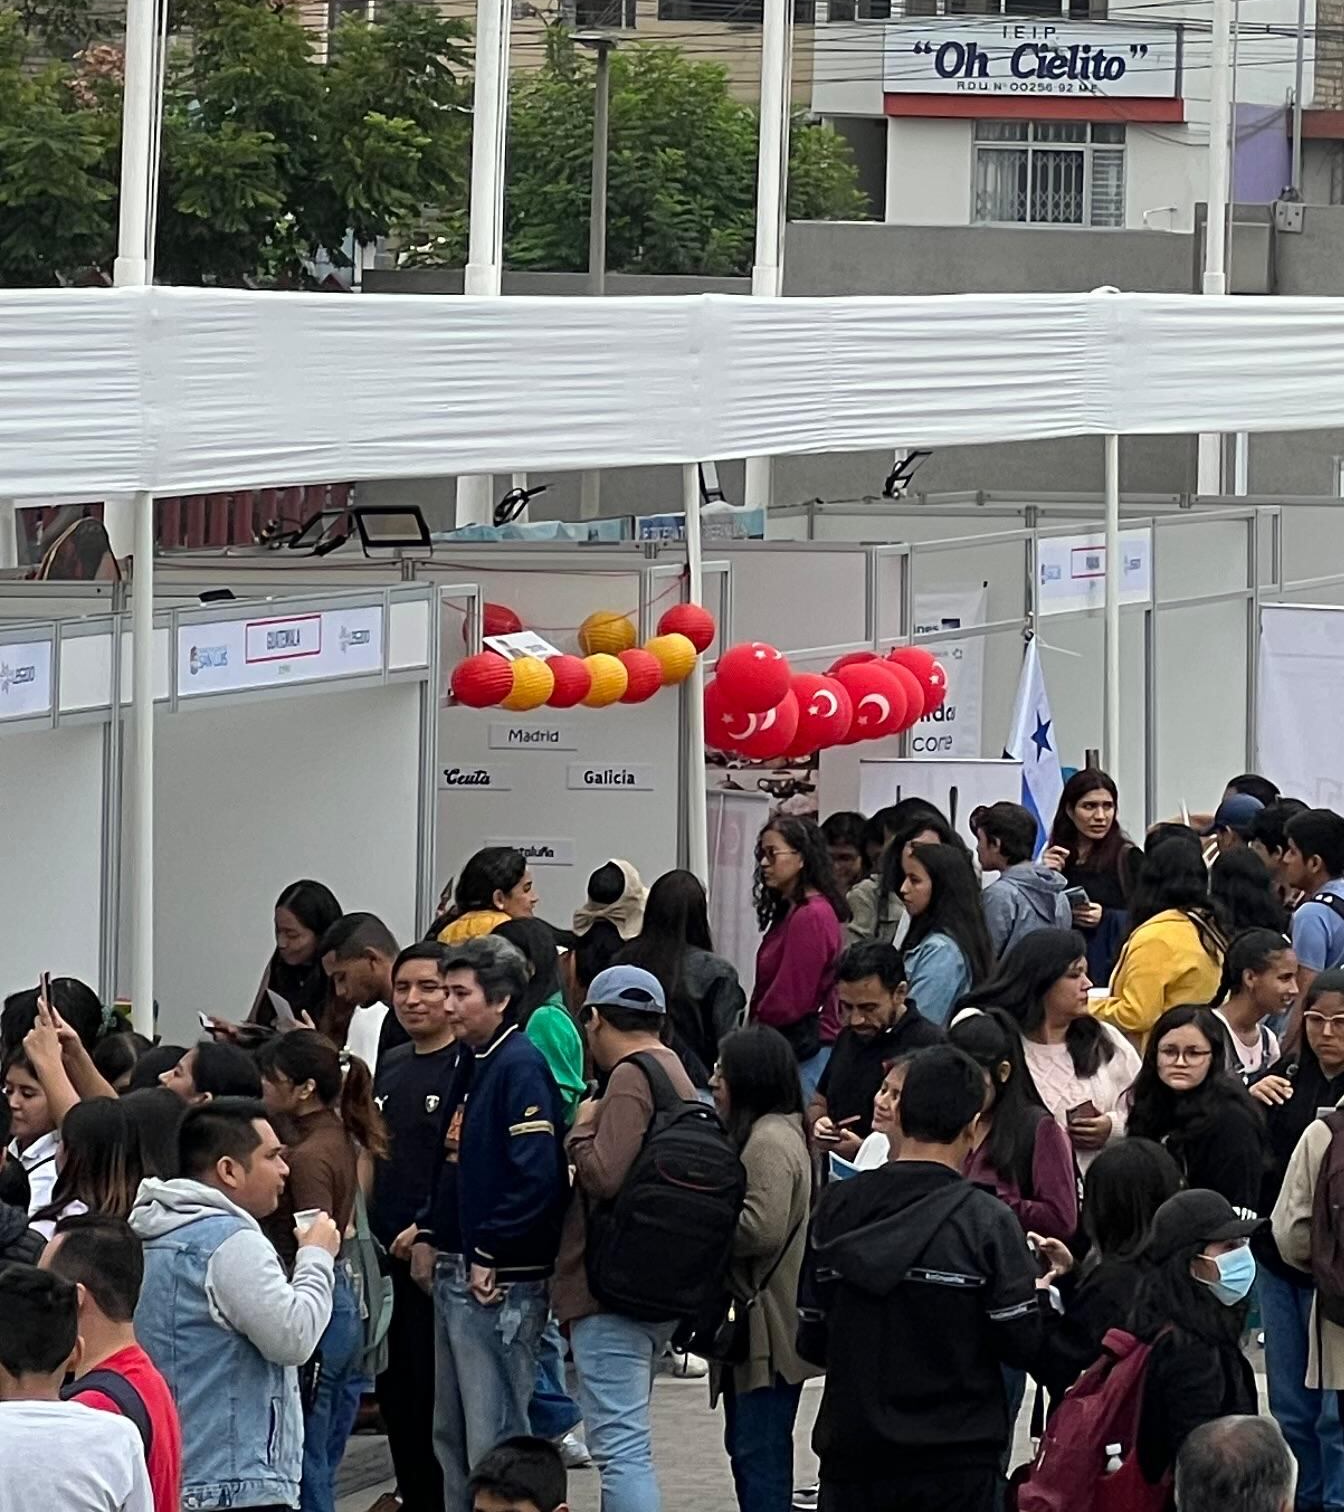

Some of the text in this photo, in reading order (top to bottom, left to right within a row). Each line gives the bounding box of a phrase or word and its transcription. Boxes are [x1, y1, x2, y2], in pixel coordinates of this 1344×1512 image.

[508, 729, 559, 743] Madrid
[443, 769, 490, 785] Ceuta
[584, 769, 635, 785] Galicia
